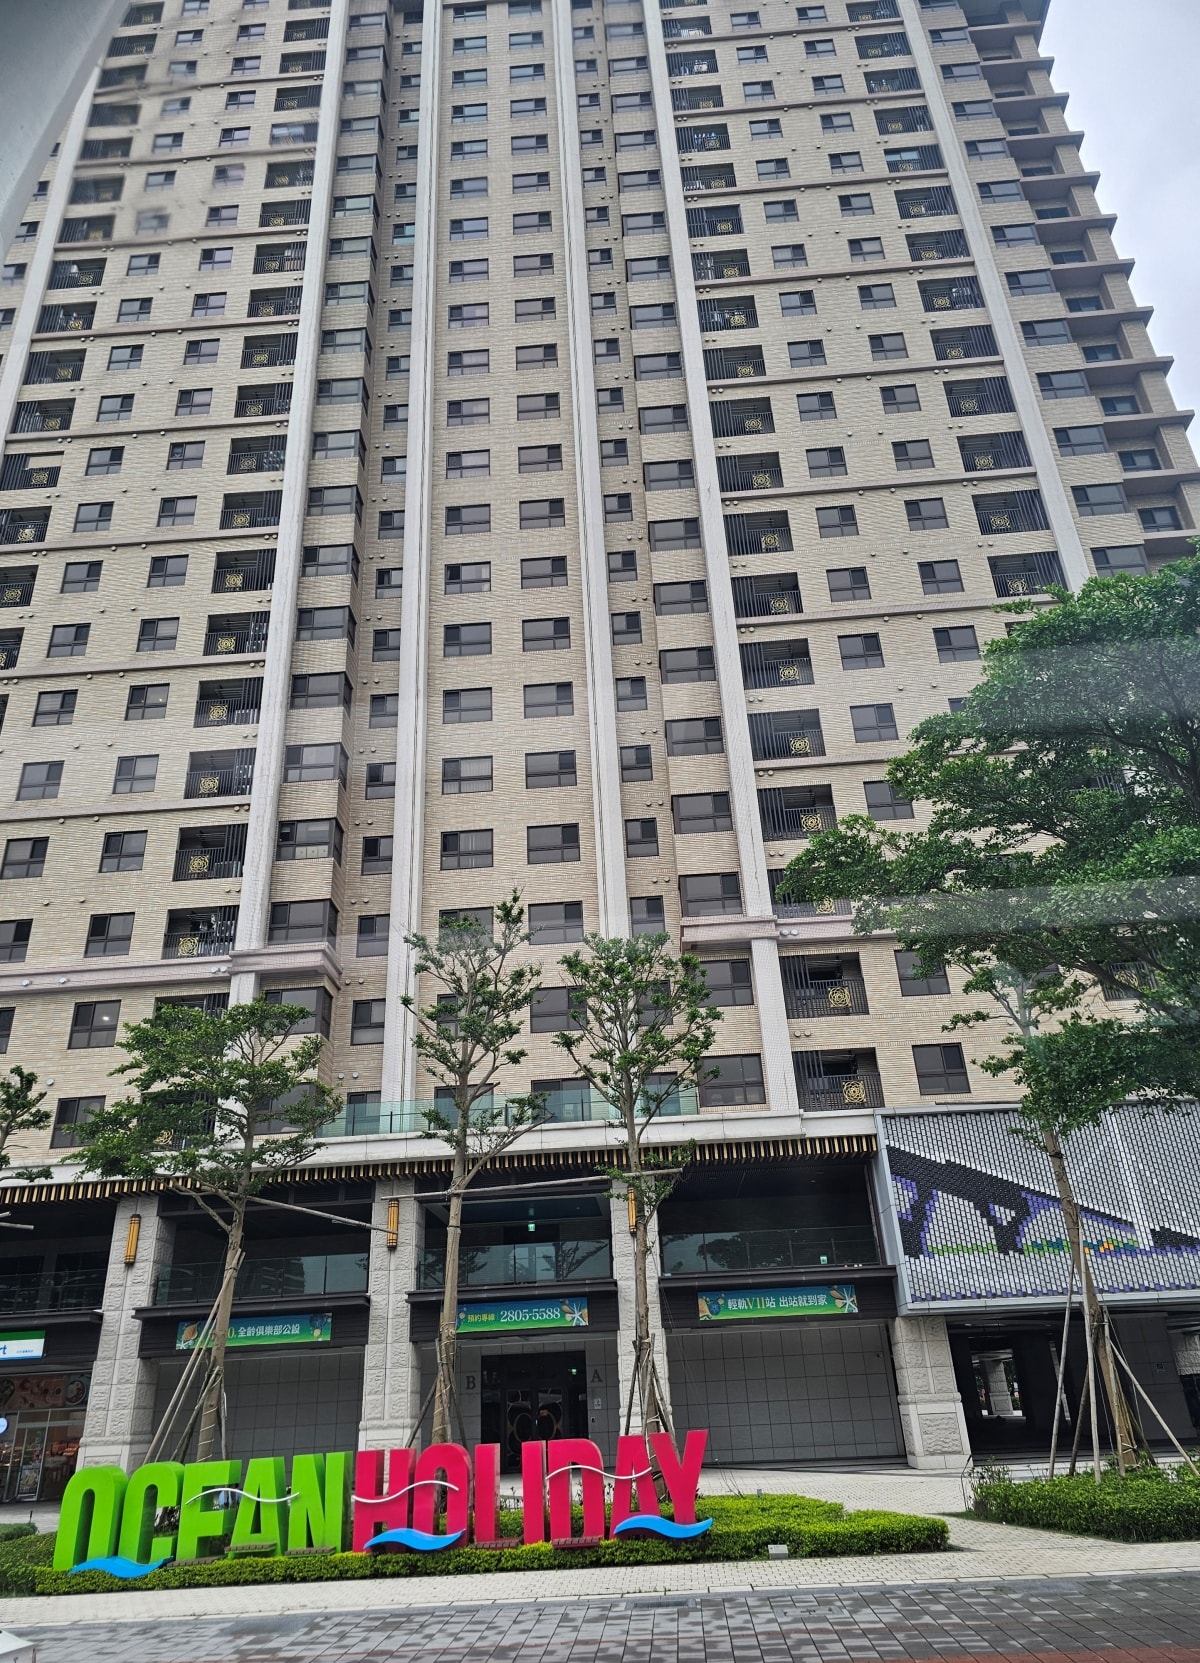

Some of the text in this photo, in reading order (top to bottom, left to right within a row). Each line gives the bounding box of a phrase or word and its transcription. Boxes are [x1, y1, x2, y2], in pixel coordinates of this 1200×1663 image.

[779, 1294, 828, 1307] 出站就到家
[500, 1308, 561, 1322] 2805-5588
[466, 1375, 476, 1390] B
[591, 1368, 603, 1383] A
[53, 1430, 708, 1571] OCEAN HOLIDAY
